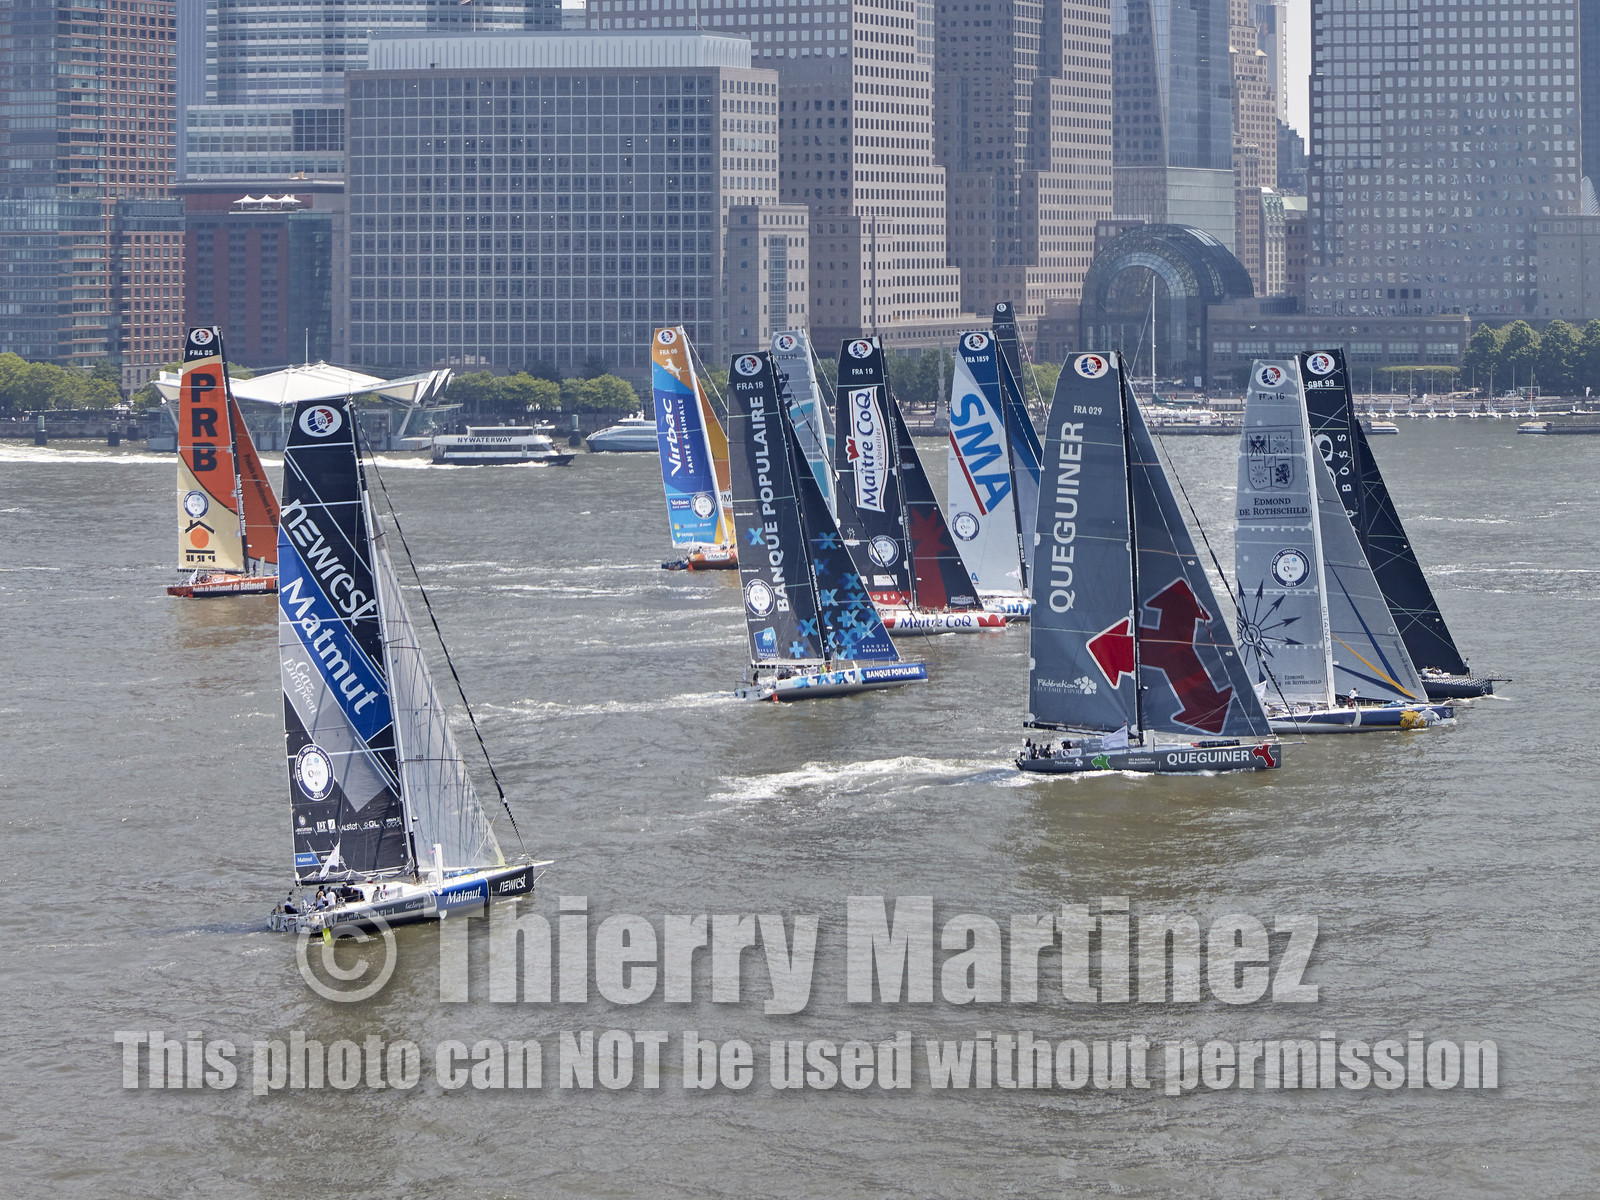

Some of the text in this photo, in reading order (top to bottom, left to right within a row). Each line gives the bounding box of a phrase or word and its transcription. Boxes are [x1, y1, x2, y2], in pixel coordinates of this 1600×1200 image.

[851, 368, 864, 376] FRA
[736, 381, 764, 391] FRA 18
[1307, 379, 1335, 389] GBR 99
[1073, 404, 1103, 416] FRA 029
[677, 398, 689, 440] ANIMALE
[663, 398, 682, 477] Virbac
[951, 393, 1012, 513] SMA
[1337, 433, 1352, 492] BOSS
[750, 396, 790, 612] BANQUE POPULAIRE
[1253, 497, 1291, 506] EDMOND
[1049, 421, 1084, 613] QUEGUINER
[1239, 506, 1308, 516] DE ROTHSCHILD
[281, 576, 379, 715] Matmut
[866, 666, 920, 679] BANQUE POPULAIRE
[1166, 750, 1250, 766] QUEGUINER
[446, 886, 482, 905] Matmut
